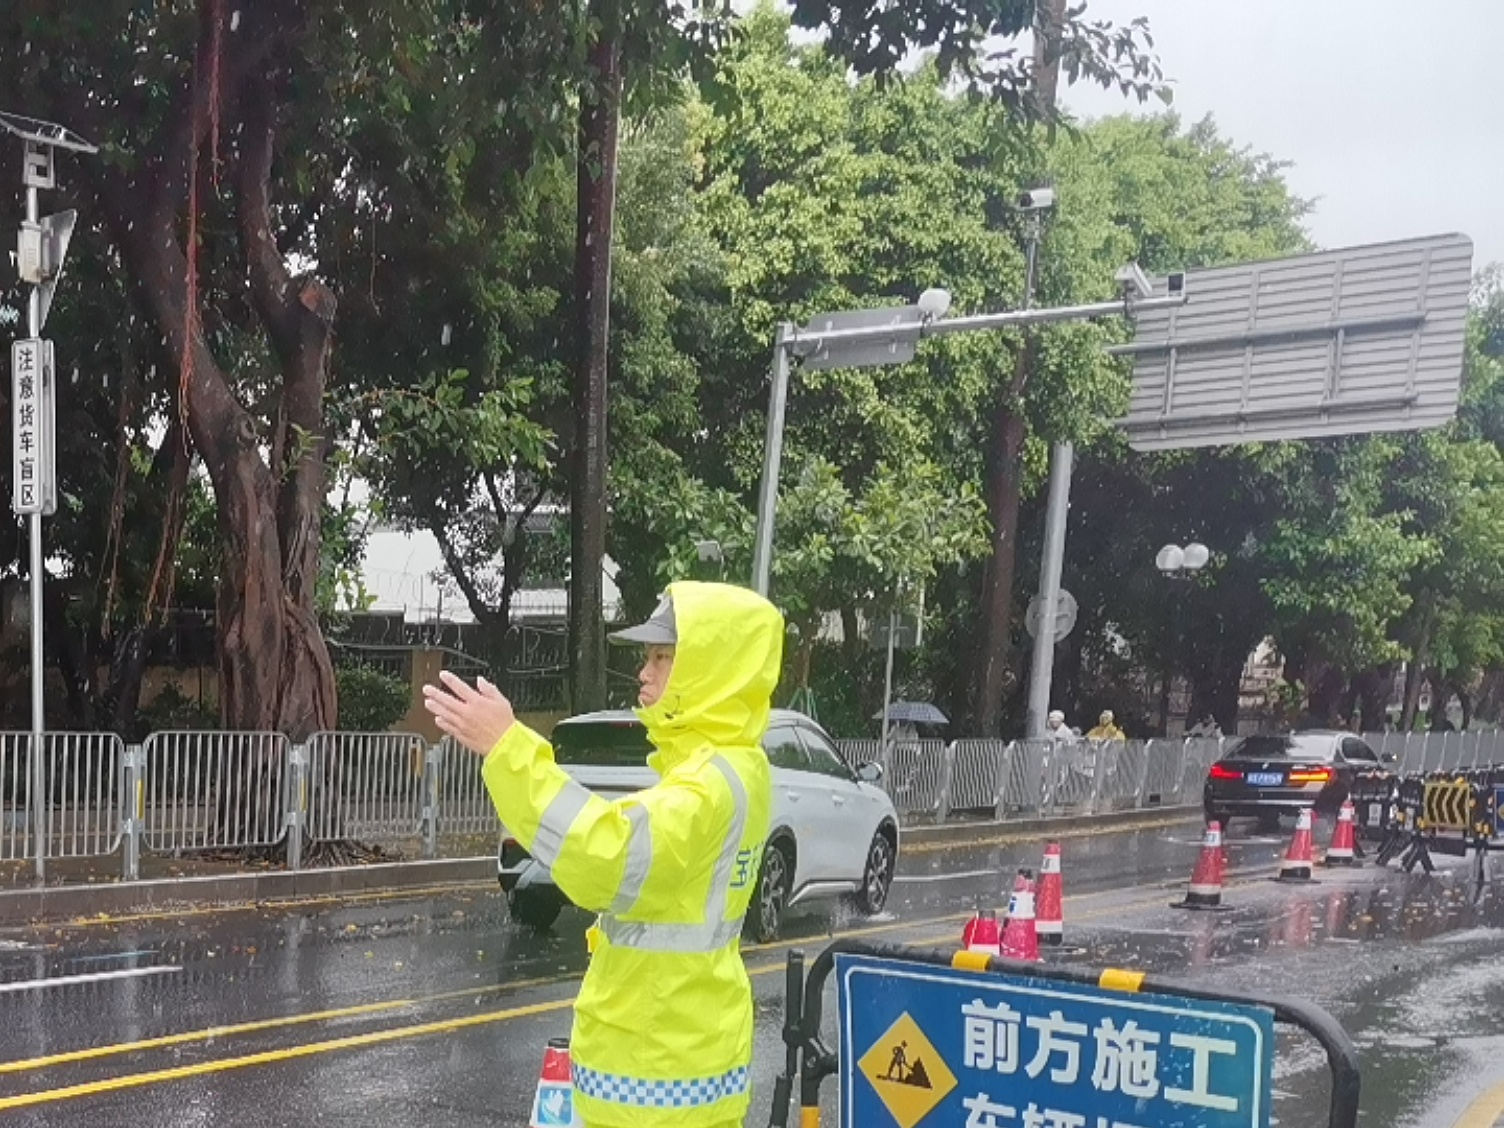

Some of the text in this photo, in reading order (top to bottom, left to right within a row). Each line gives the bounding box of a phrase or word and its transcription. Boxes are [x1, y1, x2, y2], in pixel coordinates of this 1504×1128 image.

[18, 349, 36, 506] 注意货车盲区
[961, 998, 1239, 1113] 前方施工
